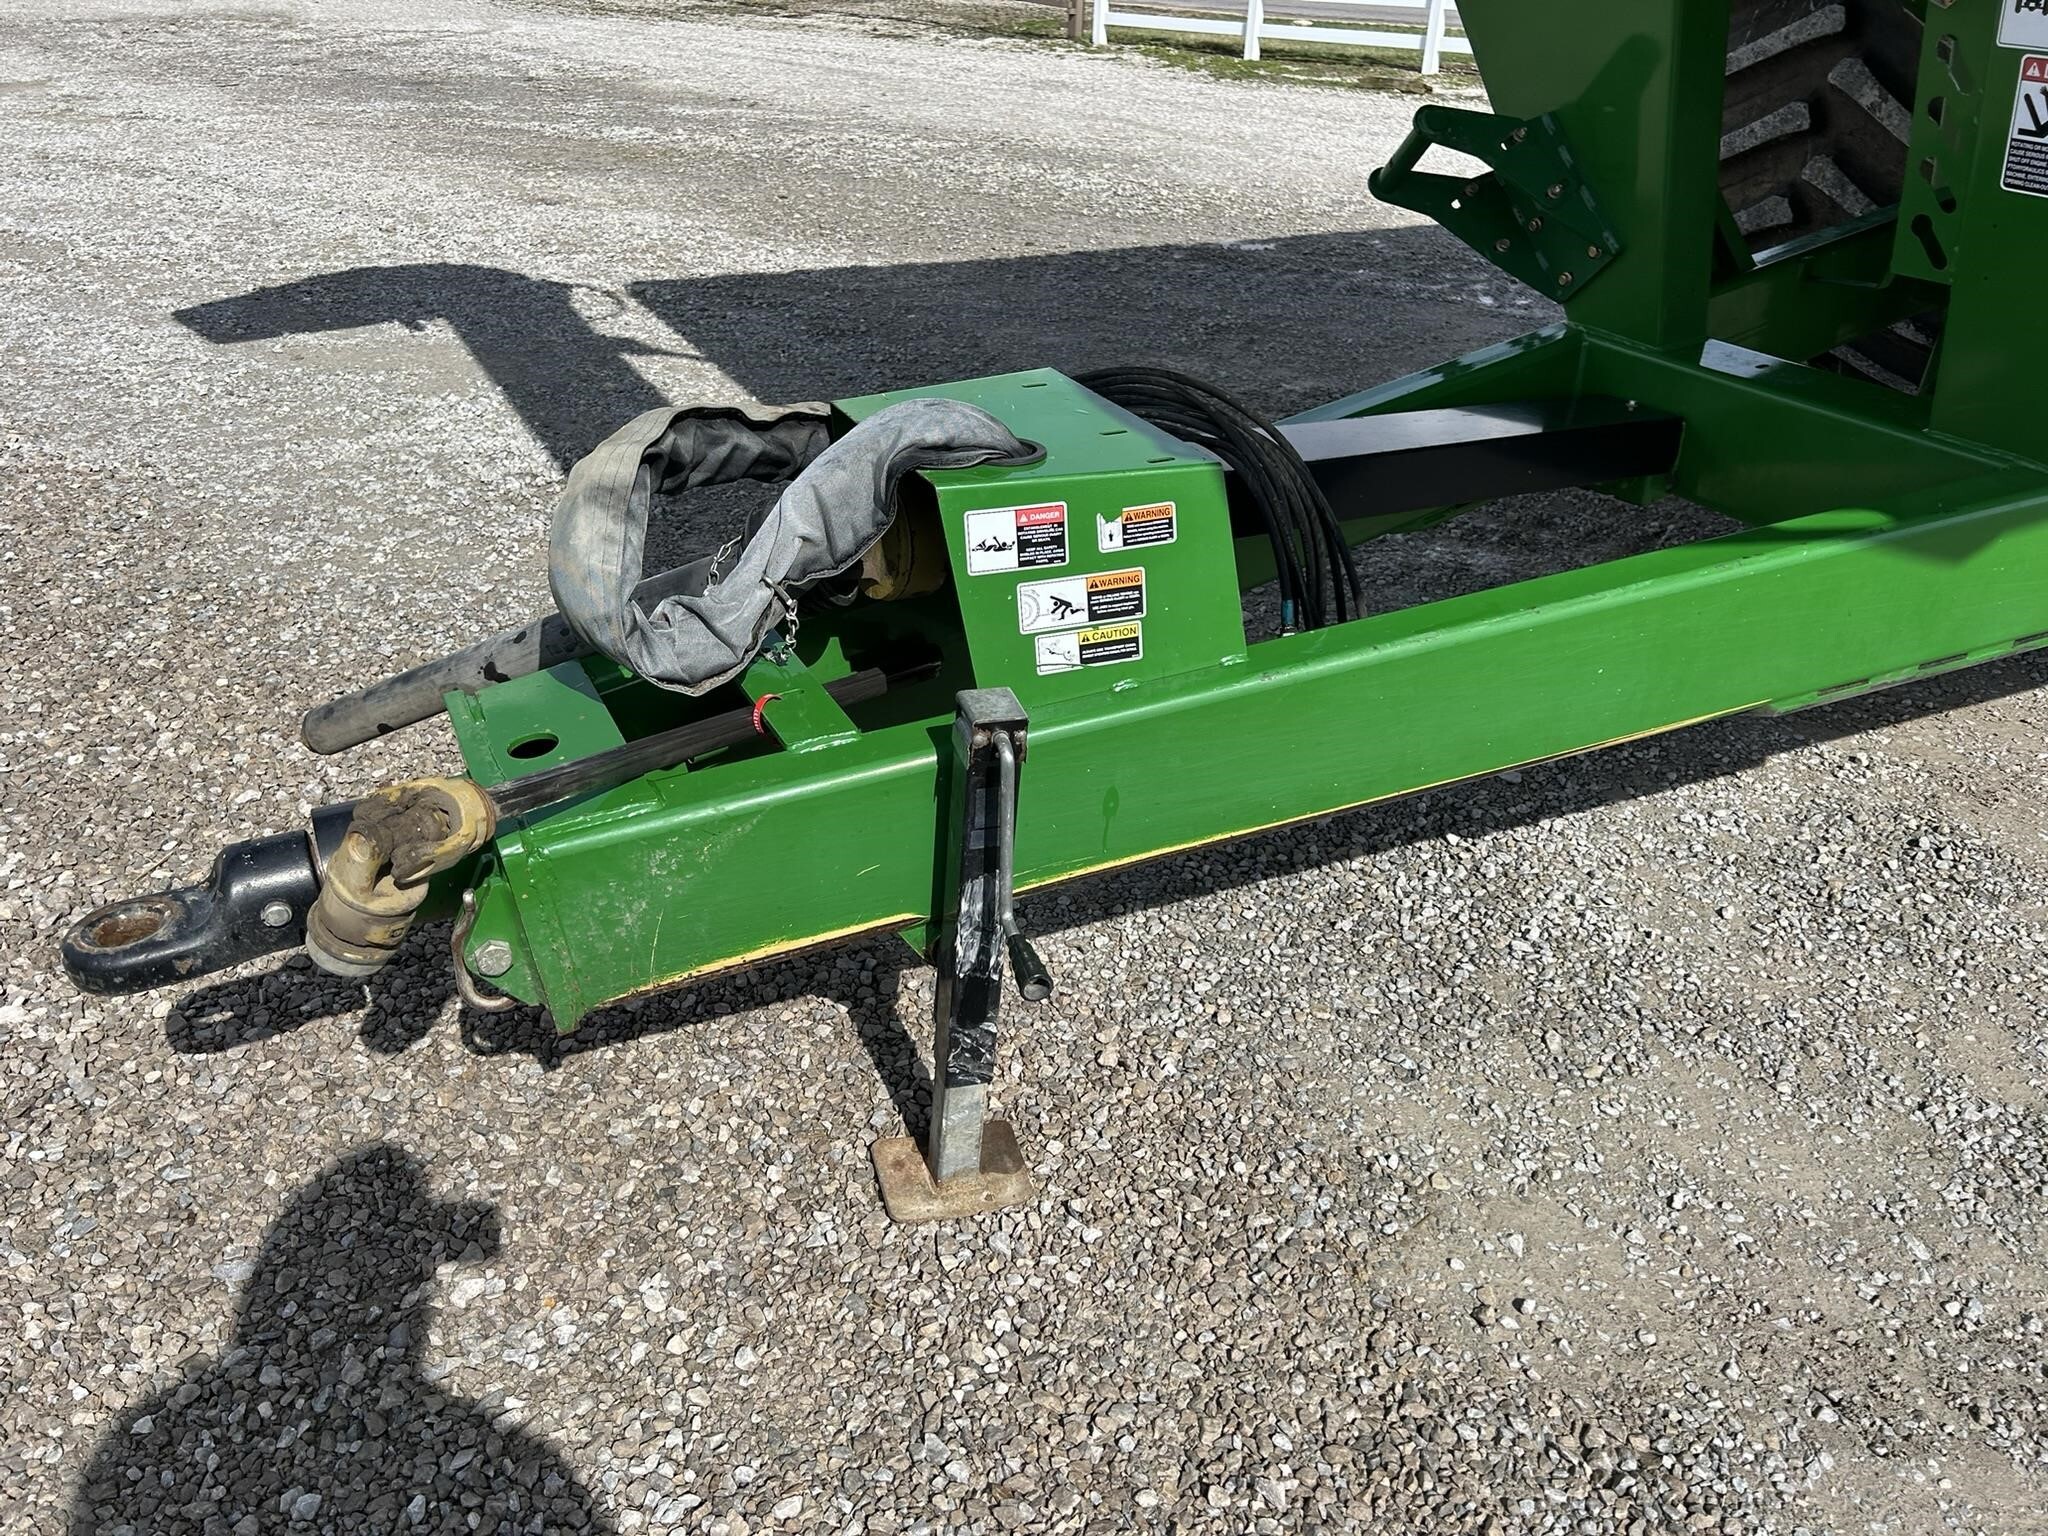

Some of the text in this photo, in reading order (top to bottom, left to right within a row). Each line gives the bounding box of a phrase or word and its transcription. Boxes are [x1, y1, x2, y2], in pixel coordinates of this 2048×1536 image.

[1029, 511, 1060, 521] DANGER
[1133, 507, 1171, 520] WARNING
[1098, 574, 1140, 588] WARNING
[1092, 626, 1137, 641] CAUTION
